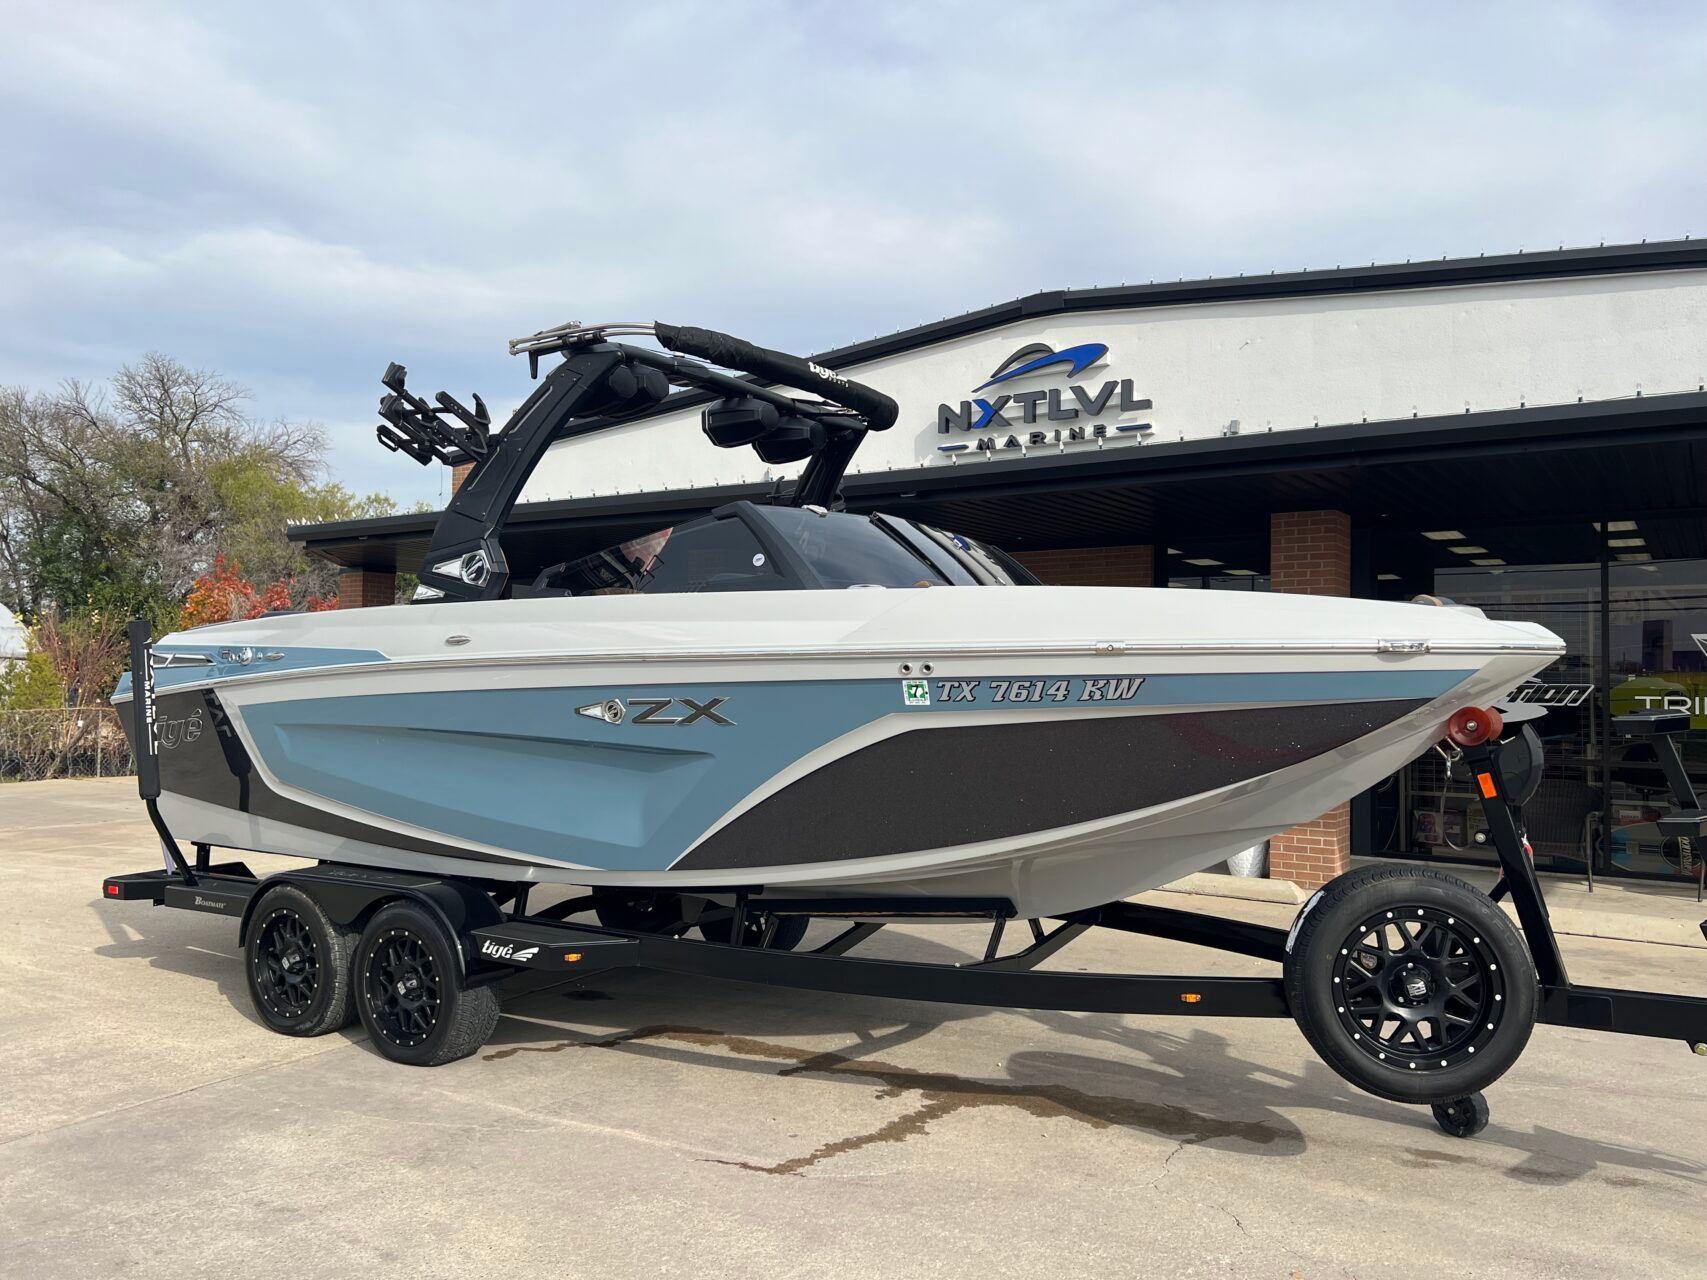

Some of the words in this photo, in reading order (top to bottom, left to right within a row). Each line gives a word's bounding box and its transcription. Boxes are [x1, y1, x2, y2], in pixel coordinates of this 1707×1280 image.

[938, 378, 1153, 433] NXTLVL
[976, 424, 1108, 450] MARINE
[144, 681, 152, 724] MARINE
[937, 680, 981, 703] TX
[989, 679, 1070, 702] 7614
[1077, 678, 1146, 702] KW
[627, 697, 738, 726] ZX
[1634, 695, 1707, 715] TRI
[155, 708, 203, 748] igé
[482, 939, 514, 959] tigé
